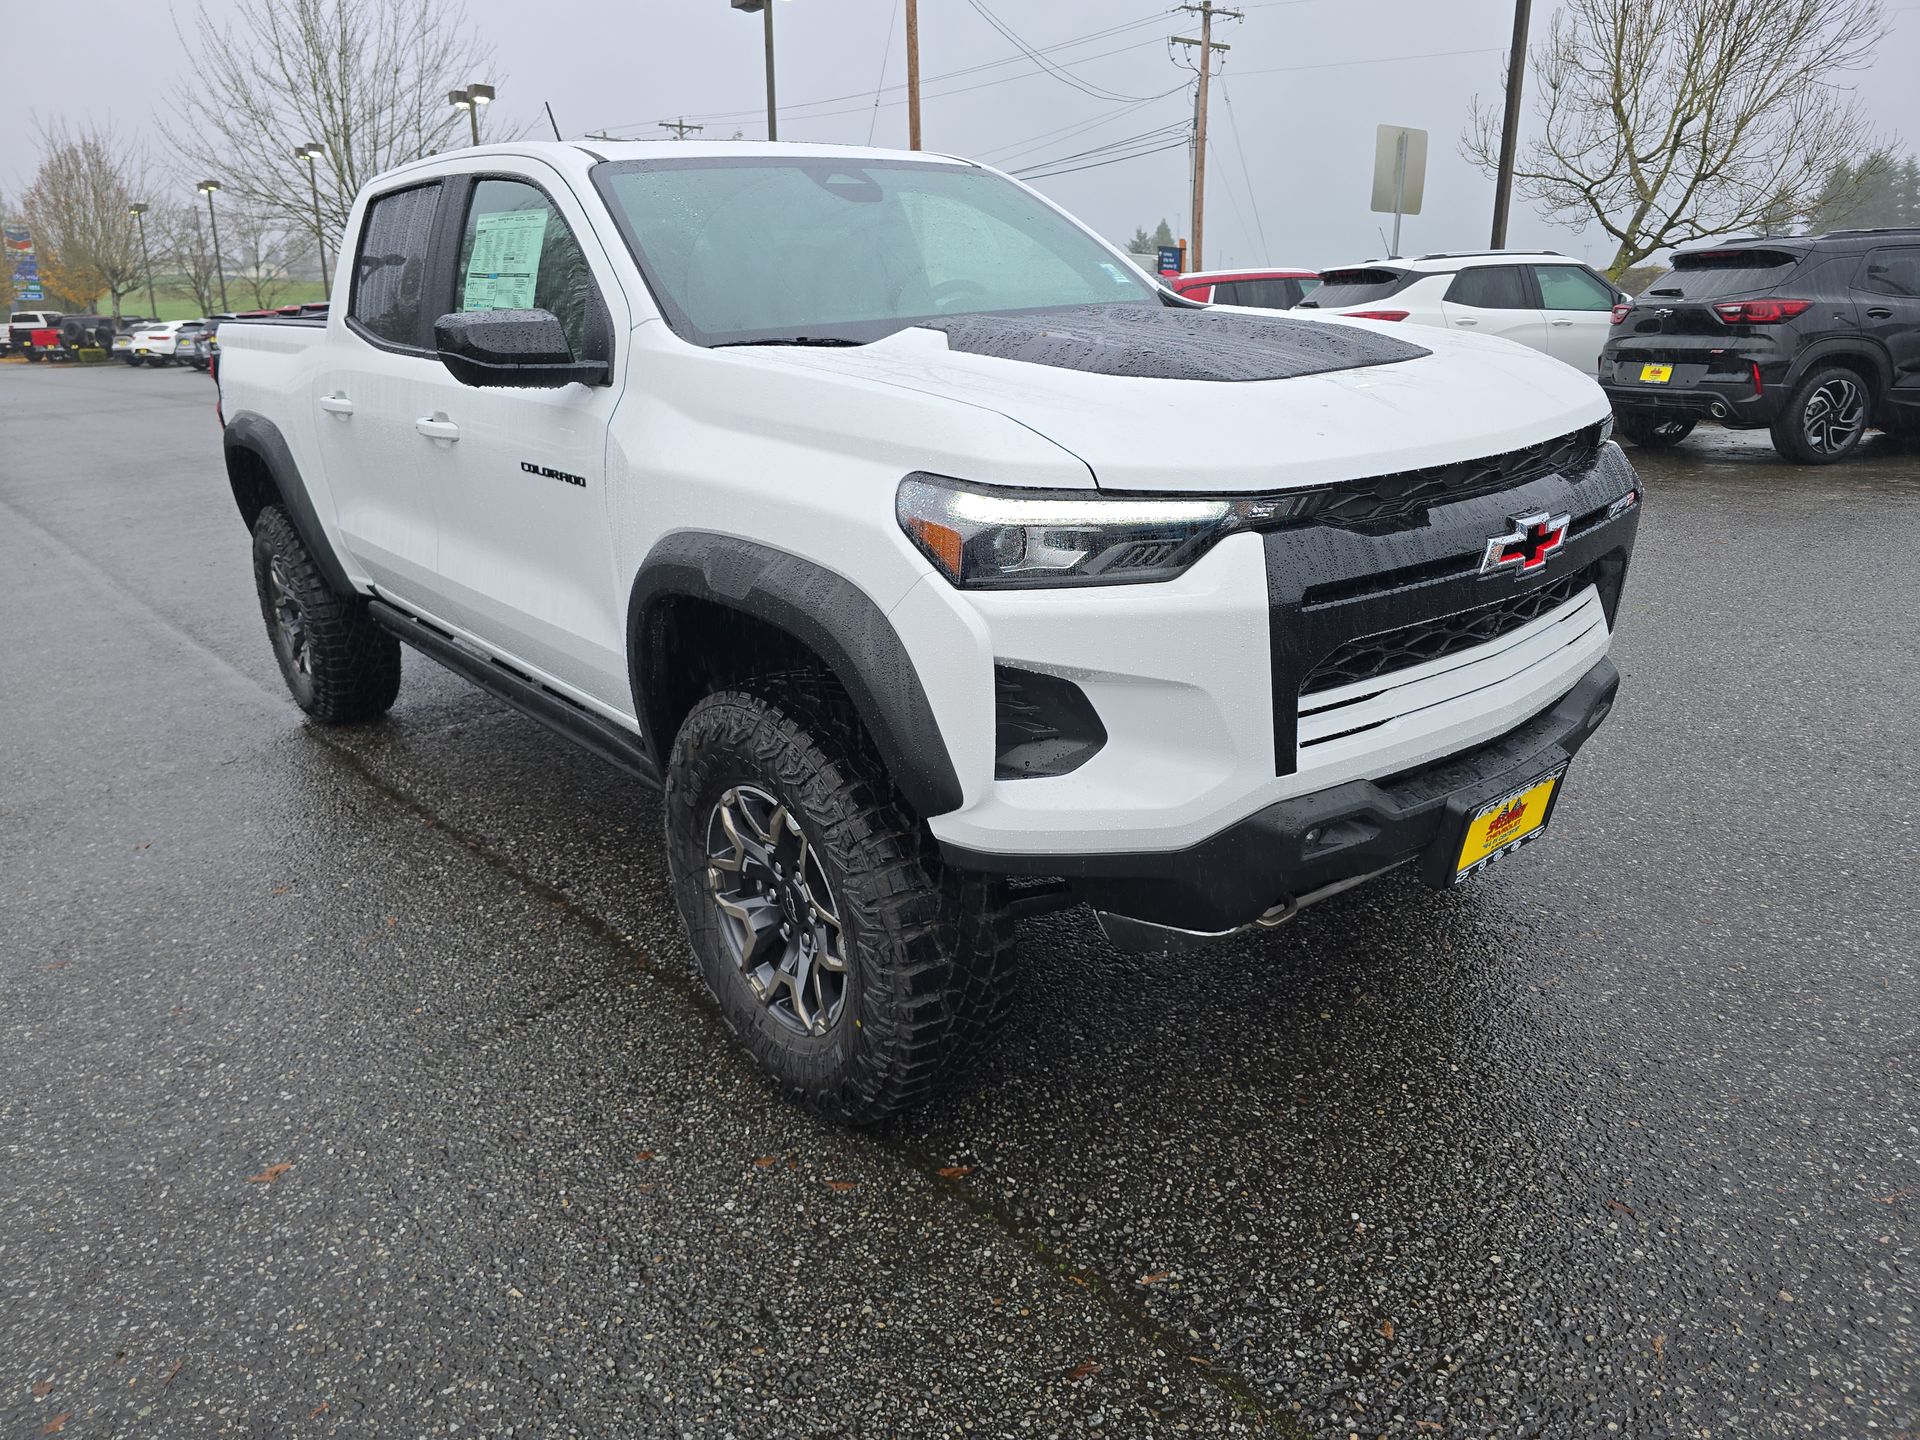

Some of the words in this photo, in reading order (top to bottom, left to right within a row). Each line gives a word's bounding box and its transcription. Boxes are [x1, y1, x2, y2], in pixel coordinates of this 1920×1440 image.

[520, 461, 587, 488] COLORADO
[1608, 491, 1635, 518] ZR2
[1485, 818, 1521, 842] CHEVROLET
